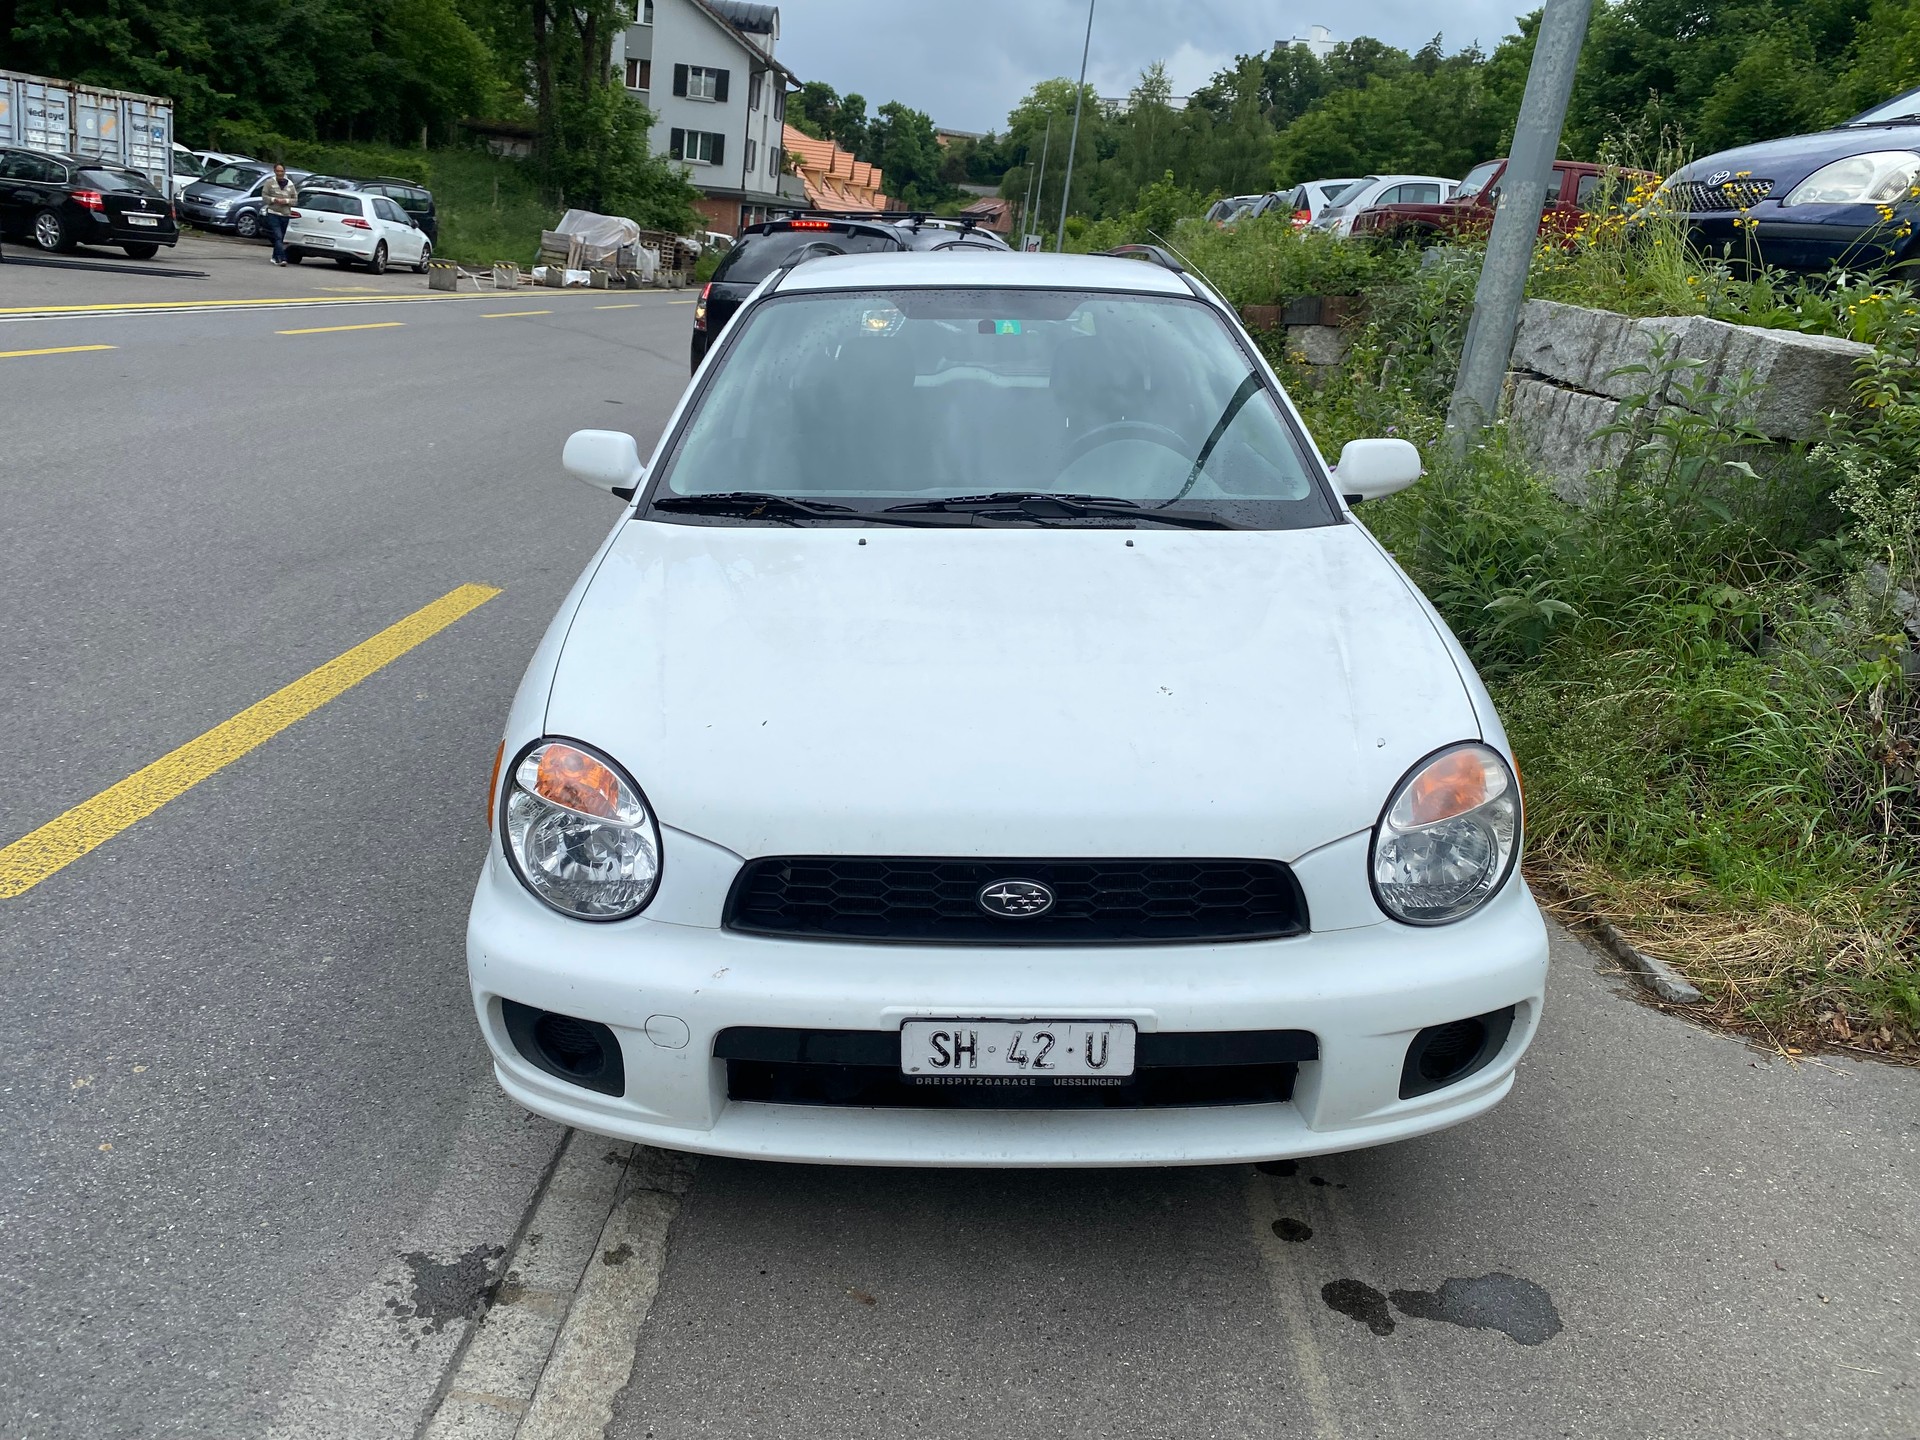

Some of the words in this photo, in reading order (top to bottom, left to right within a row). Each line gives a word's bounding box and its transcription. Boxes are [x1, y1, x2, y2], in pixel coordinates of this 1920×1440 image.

[27, 108, 64, 120] Nedloyd
[928, 1030, 978, 1069] SH
[1006, 1030, 1055, 1069] 42
[1085, 1031, 1109, 1069] U
[916, 1077, 1036, 1086] DREISPITZGARAGE
[1053, 1078, 1122, 1086] UESSLINGEN
